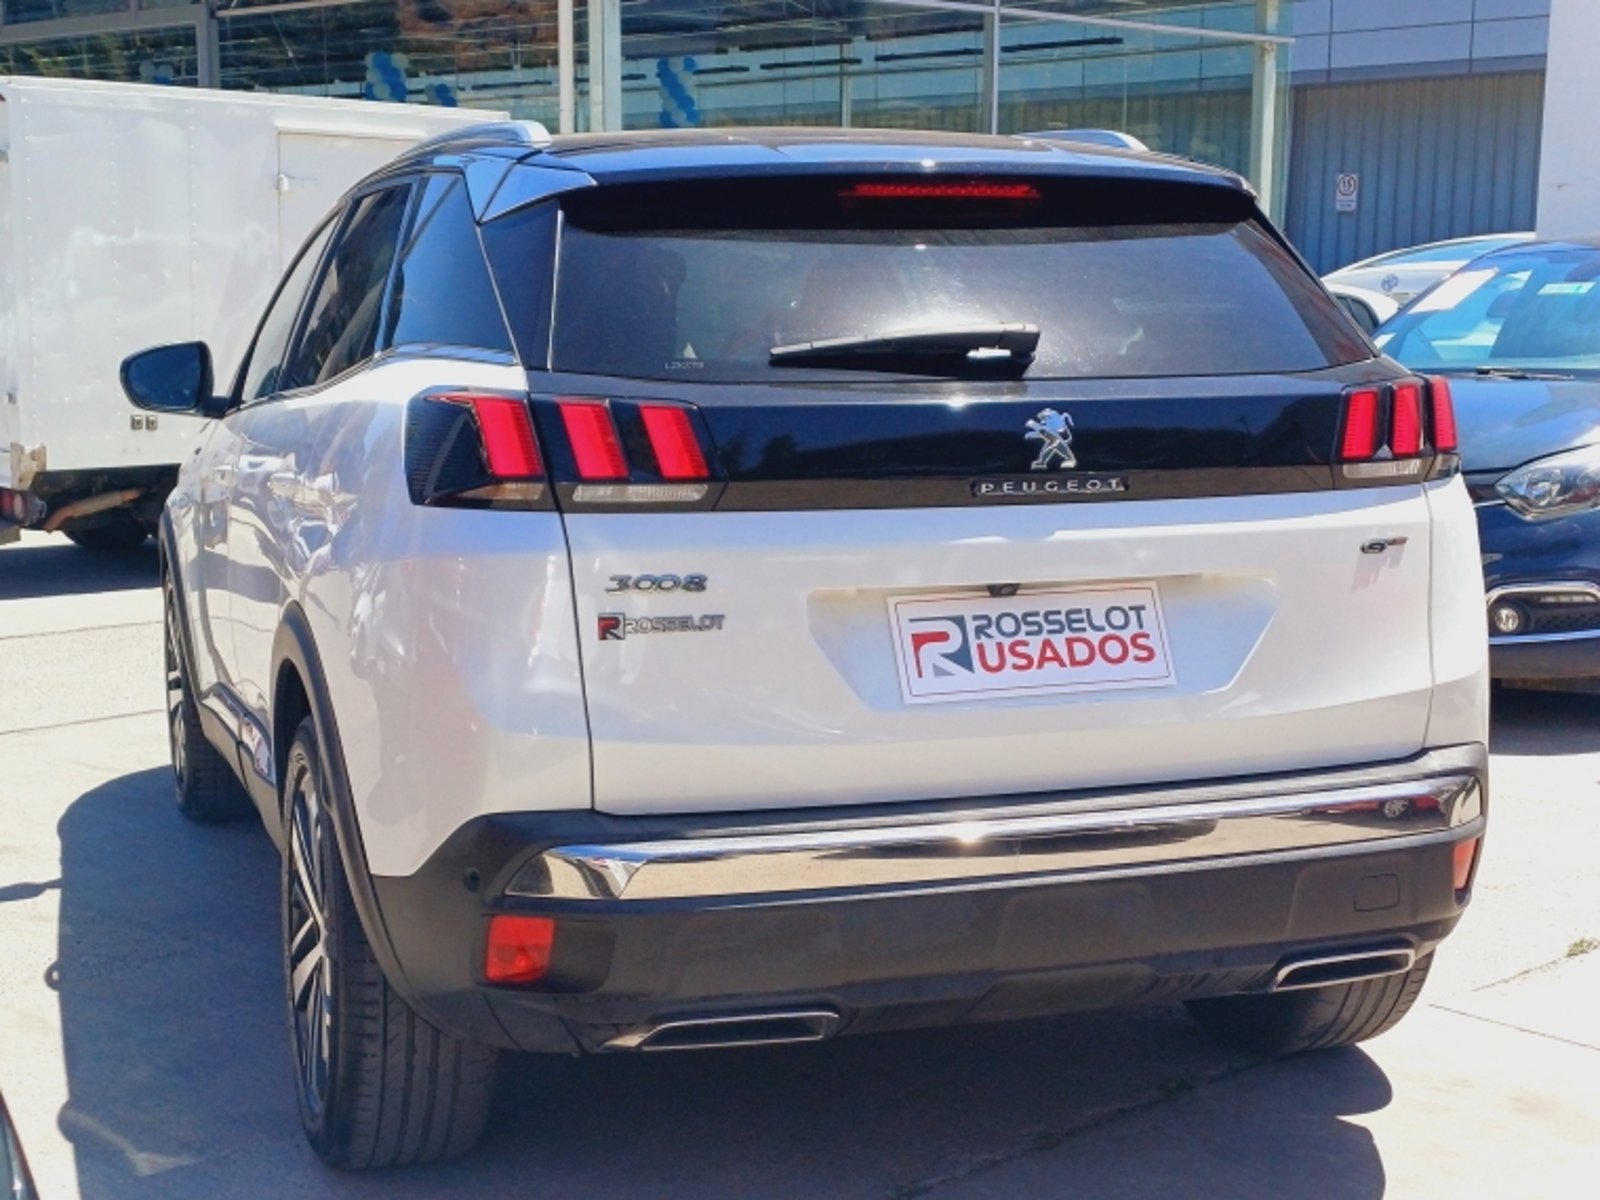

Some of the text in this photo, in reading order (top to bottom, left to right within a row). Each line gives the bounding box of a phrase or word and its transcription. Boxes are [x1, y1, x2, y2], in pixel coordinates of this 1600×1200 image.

[980, 478, 1122, 494] PEUGEOT
[605, 573, 708, 592] 3008
[625, 614, 726, 634] ROSSELOT
[971, 604, 1147, 640] ROSSELOT
[976, 632, 1156, 673] USADOS
